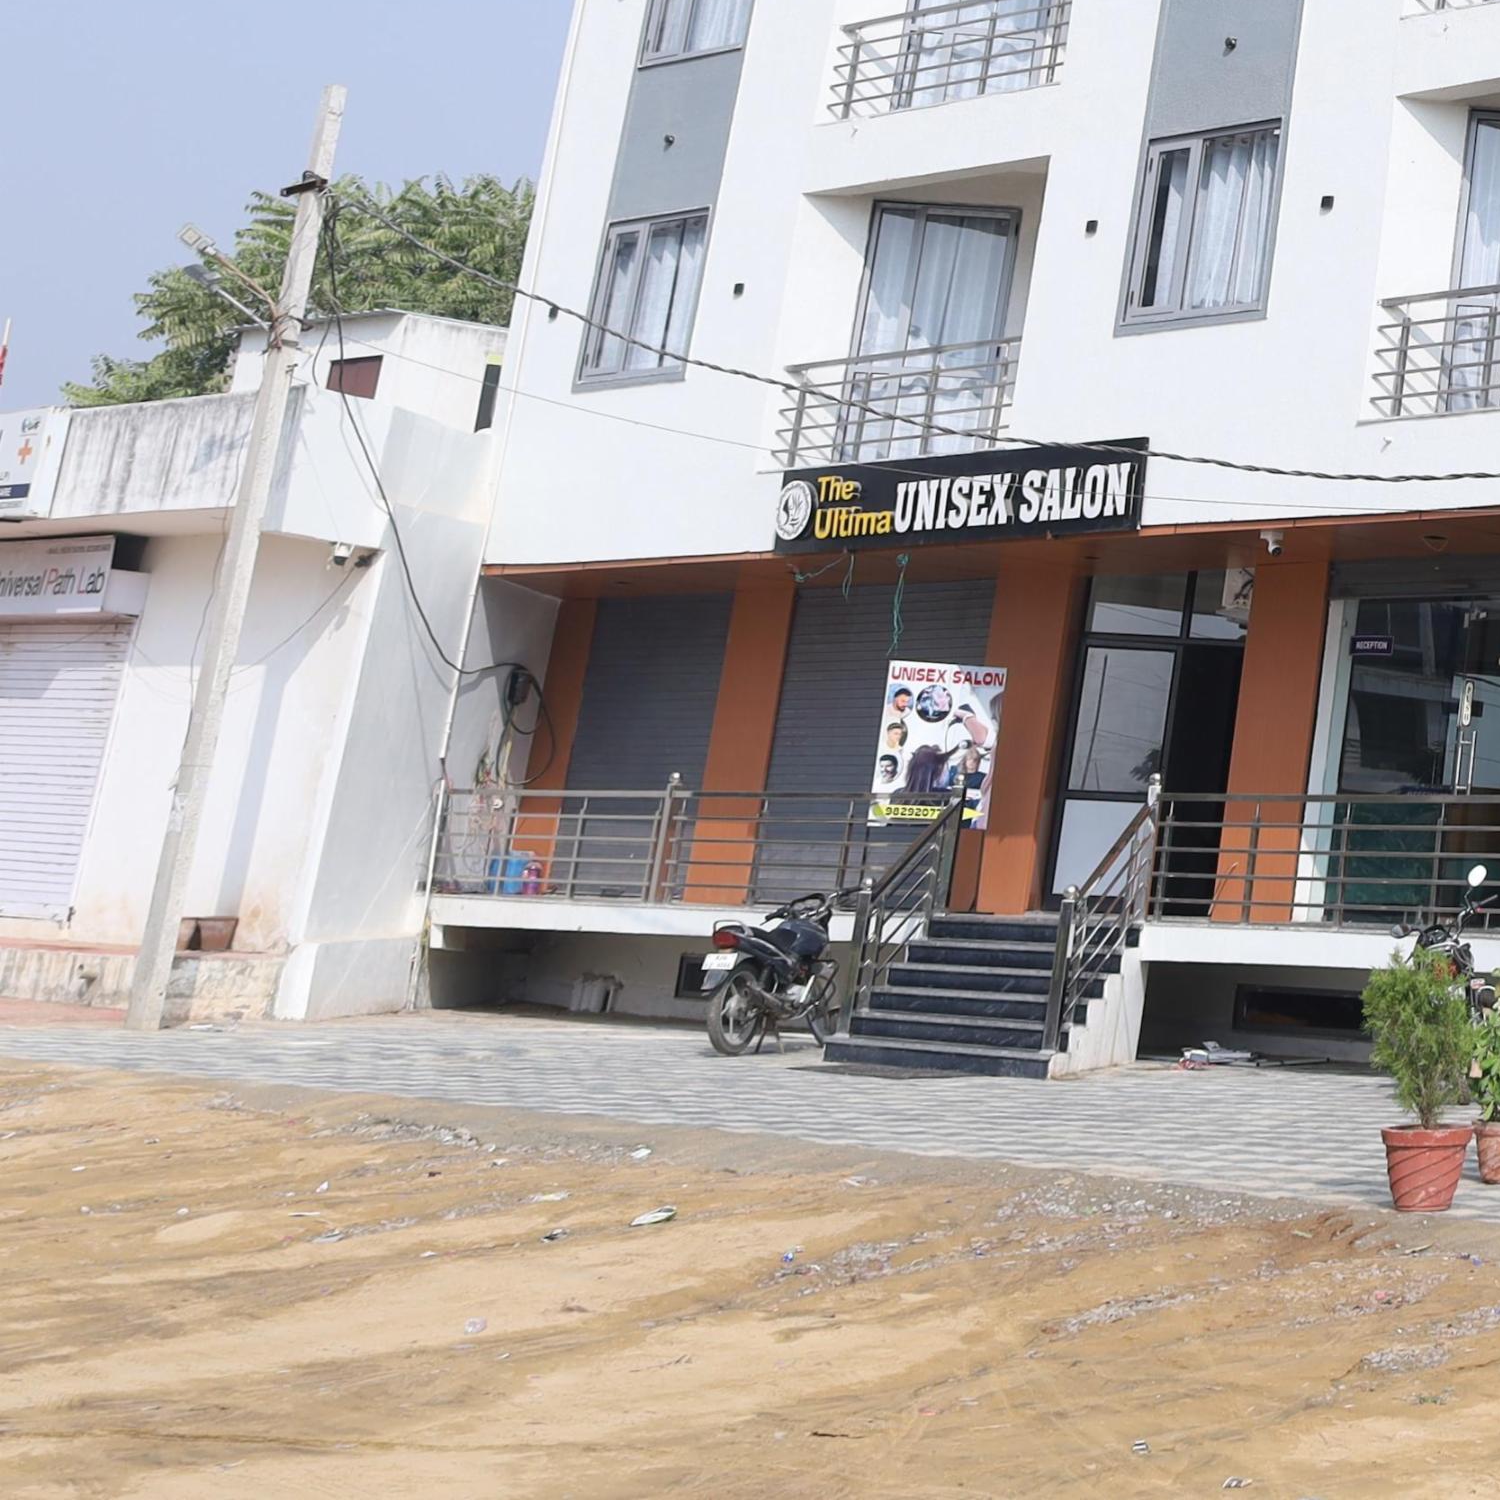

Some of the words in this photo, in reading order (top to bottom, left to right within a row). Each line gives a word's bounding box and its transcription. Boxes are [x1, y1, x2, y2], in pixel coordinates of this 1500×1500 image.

[817, 475, 857, 503] The
[893, 472, 1013, 534] UNISEX
[1018, 461, 1133, 525] SALON
[813, 506, 893, 541] Ultima
[77, 565, 106, 595] Lab
[1355, 640, 1388, 650] RECEPTION
[891, 666, 948, 684] UNISEX
[952, 671, 1006, 687] SALON
